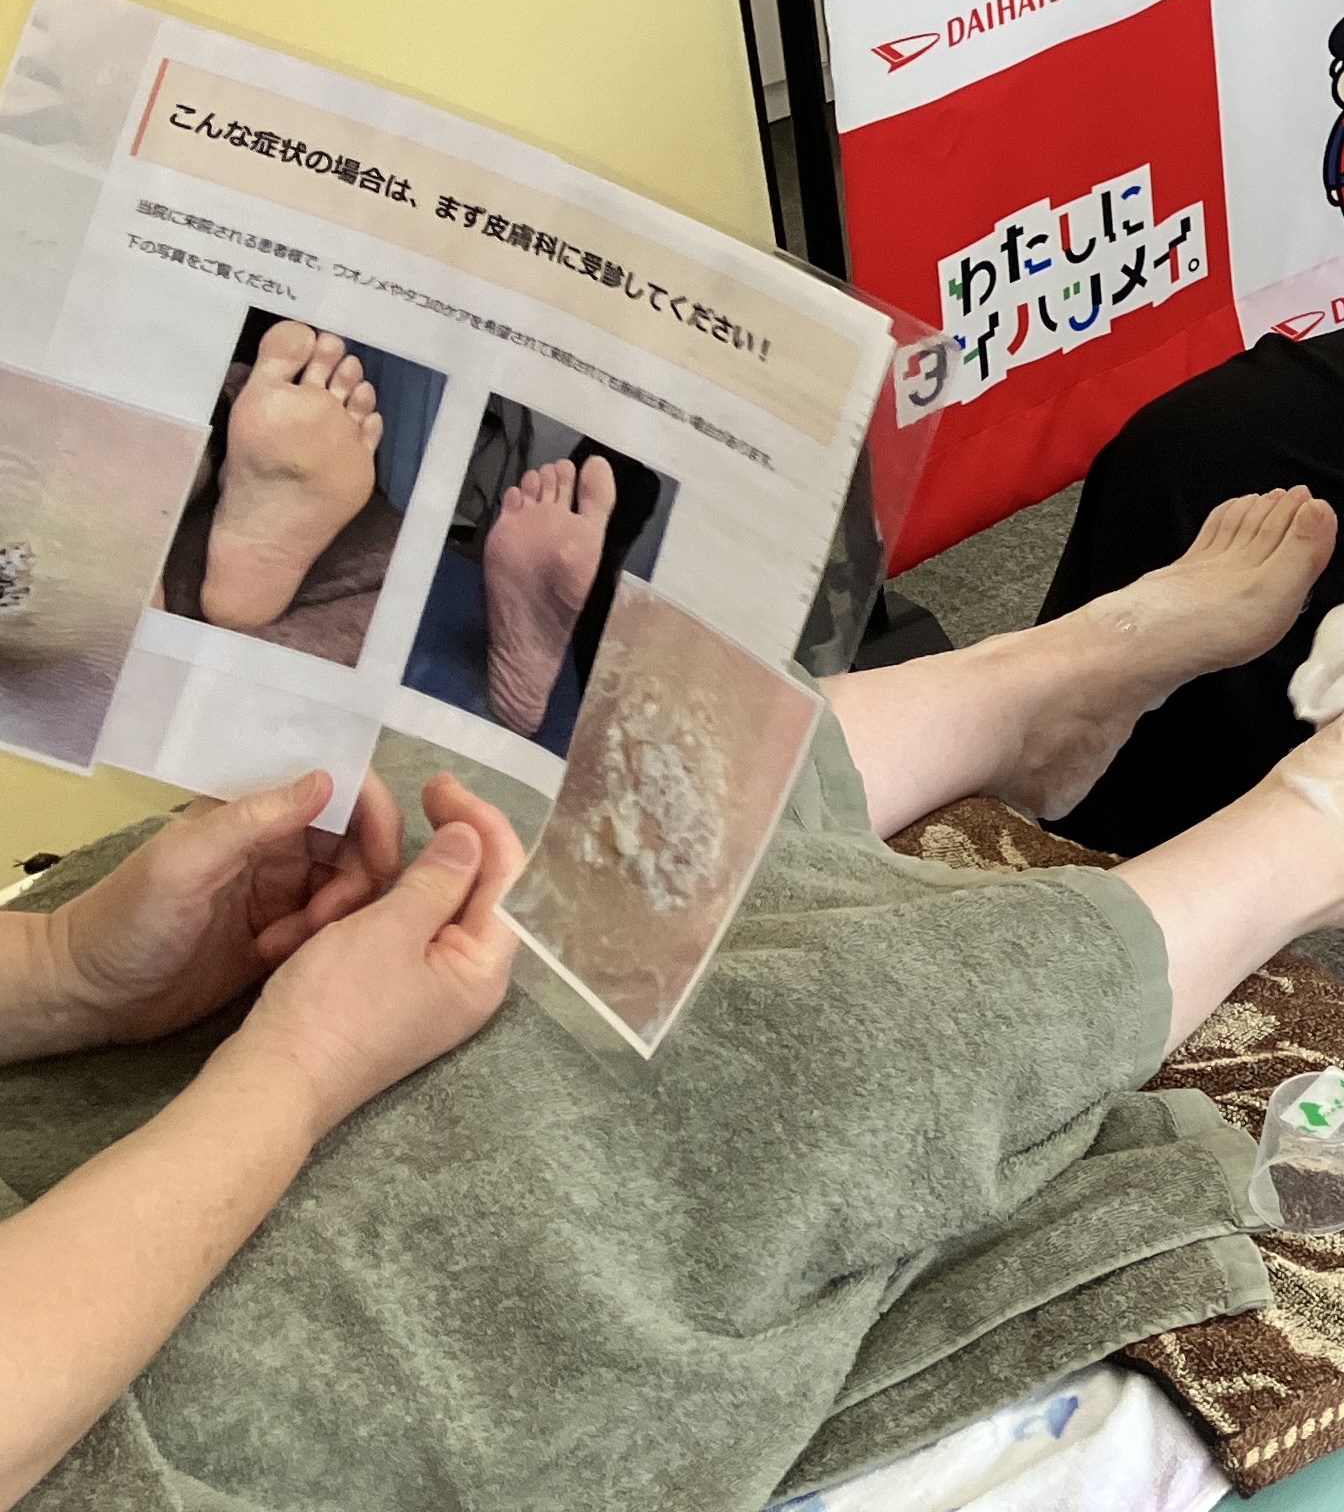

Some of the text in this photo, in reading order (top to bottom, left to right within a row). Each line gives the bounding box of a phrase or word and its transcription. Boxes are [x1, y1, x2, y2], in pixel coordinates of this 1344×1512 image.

[902, 216, 1200, 407] ダイハツメイ。
[949, 185, 1144, 316] わたしに
